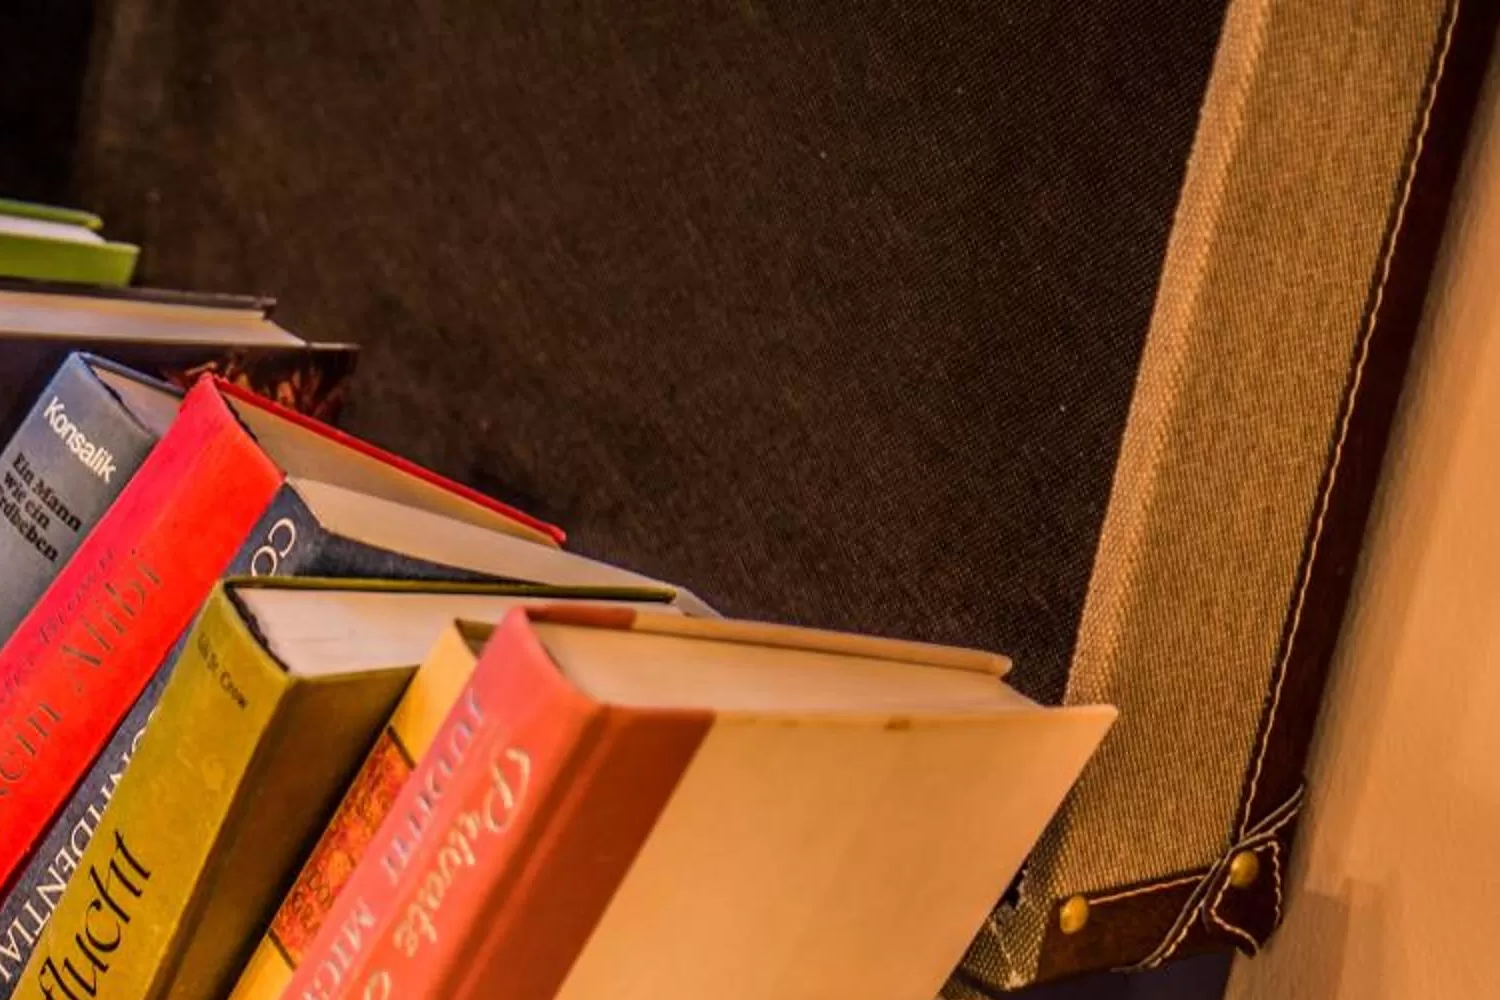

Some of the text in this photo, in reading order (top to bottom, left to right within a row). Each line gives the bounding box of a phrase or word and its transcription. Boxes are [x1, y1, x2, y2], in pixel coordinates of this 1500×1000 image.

[12, 451, 82, 533] Ein Mann
[43, 395, 117, 485] Konsalik
[4, 471, 51, 531] wie ein
[61, 548, 162, 694] Alibi
[381, 687, 488, 887] JUDITH
[393, 747, 532, 960] Private
